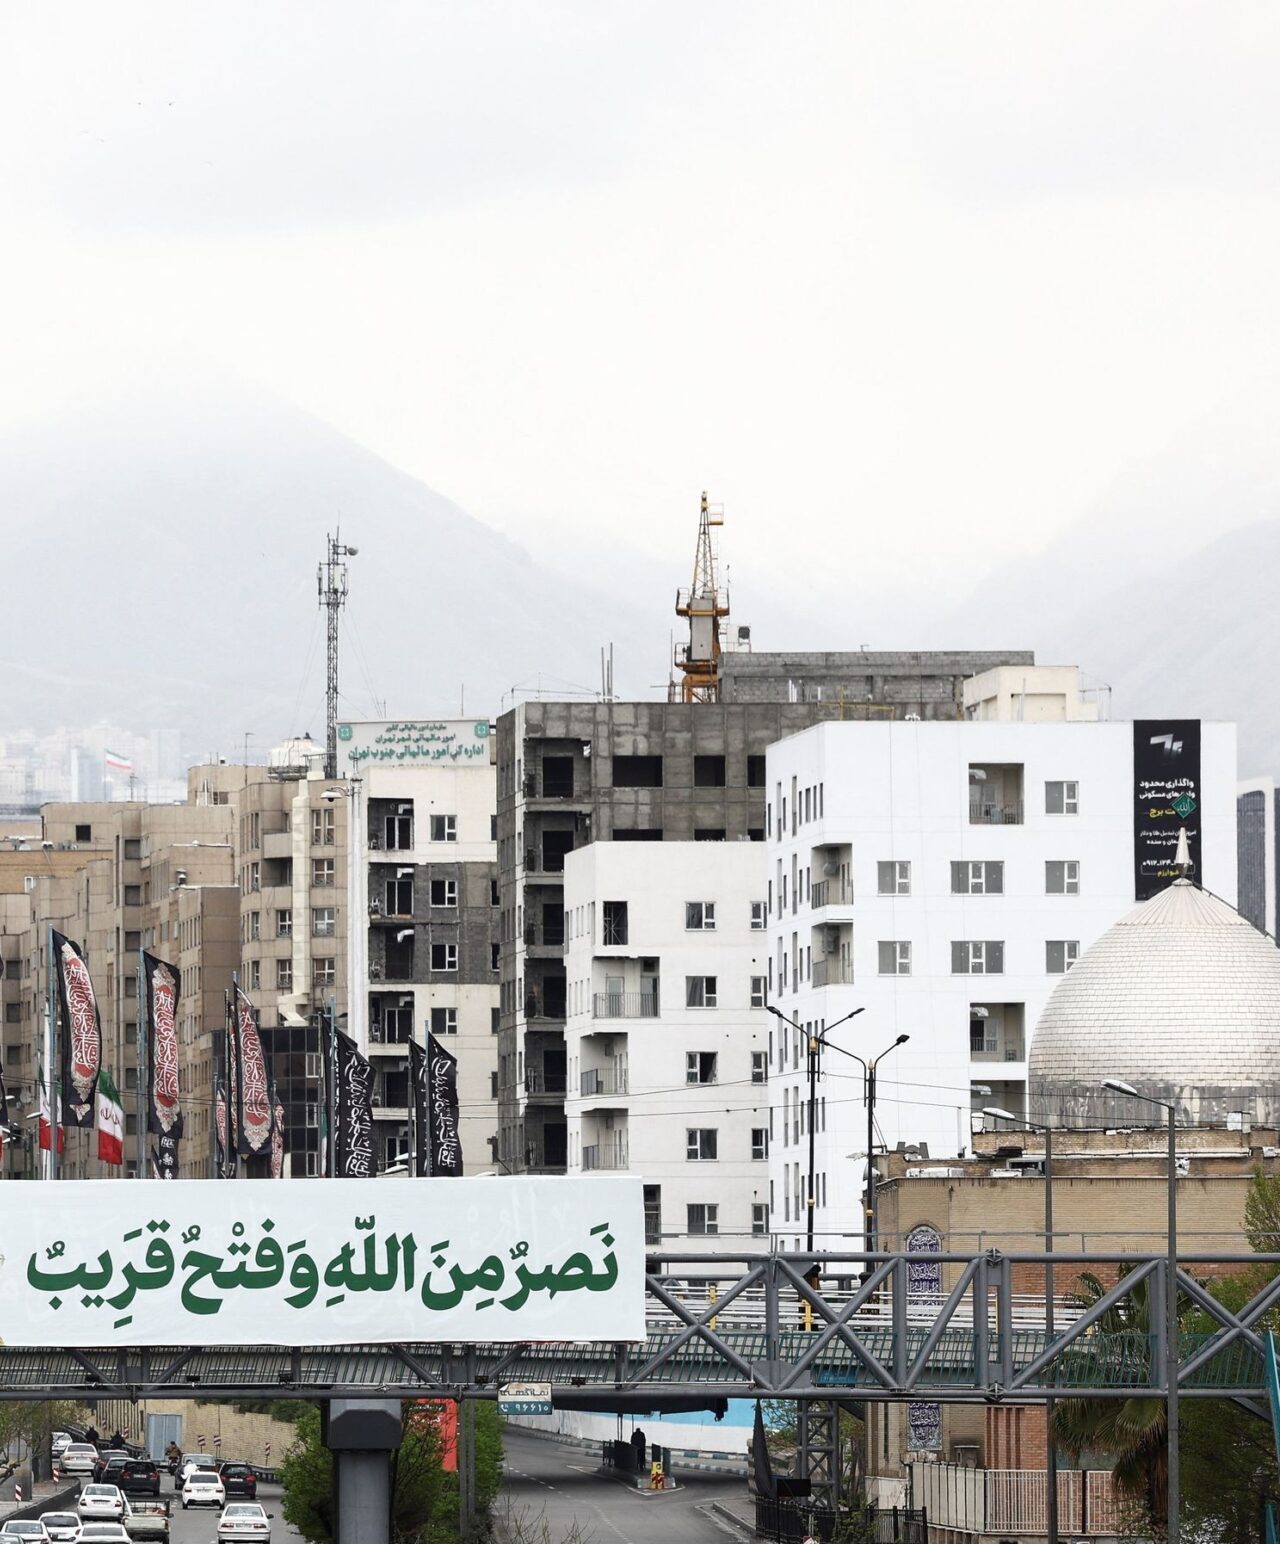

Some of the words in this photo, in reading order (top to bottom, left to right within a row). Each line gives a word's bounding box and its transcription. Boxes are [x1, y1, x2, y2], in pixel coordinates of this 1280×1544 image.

[348, 746, 370, 760] تهران
[371, 747, 395, 760] جنوب
[396, 745, 430, 759] مالیاتی
[431, 745, 449, 758] امور
[464, 744, 484, 757] اداره
[1139, 781, 1165, 789] محدود
[1166, 778, 1194, 789] واگذاری
[1139, 790, 1166, 799] مسکونی
[1149, 808, 1164, 818] برج
